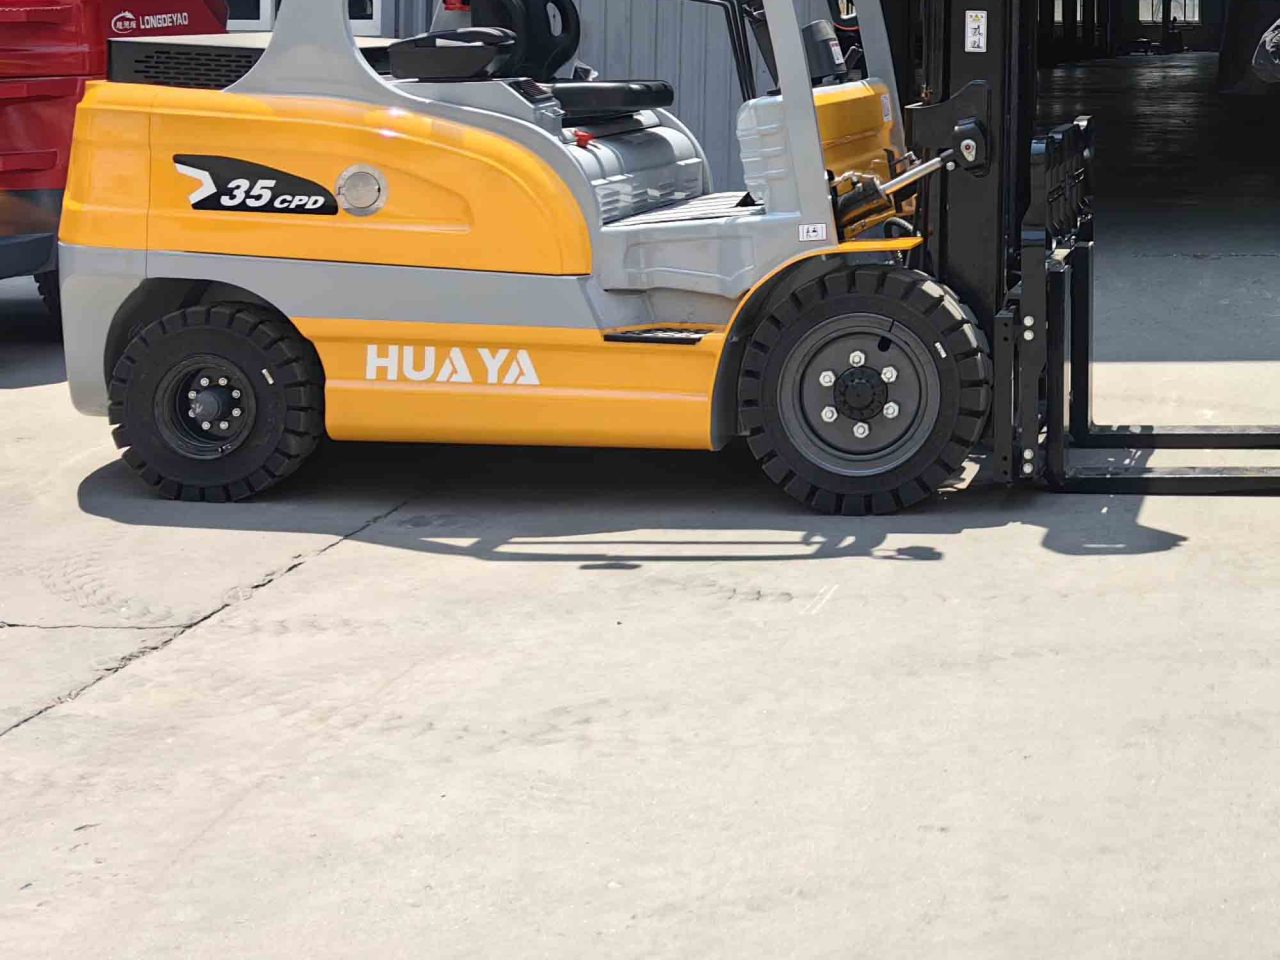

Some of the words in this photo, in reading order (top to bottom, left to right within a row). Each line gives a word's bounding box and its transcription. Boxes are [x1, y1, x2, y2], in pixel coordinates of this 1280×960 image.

[139, 12, 189, 29] LONGDEYAO
[220, 178, 277, 208] 35
[273, 194, 325, 210] CPD
[365, 344, 540, 386] HUAYA
